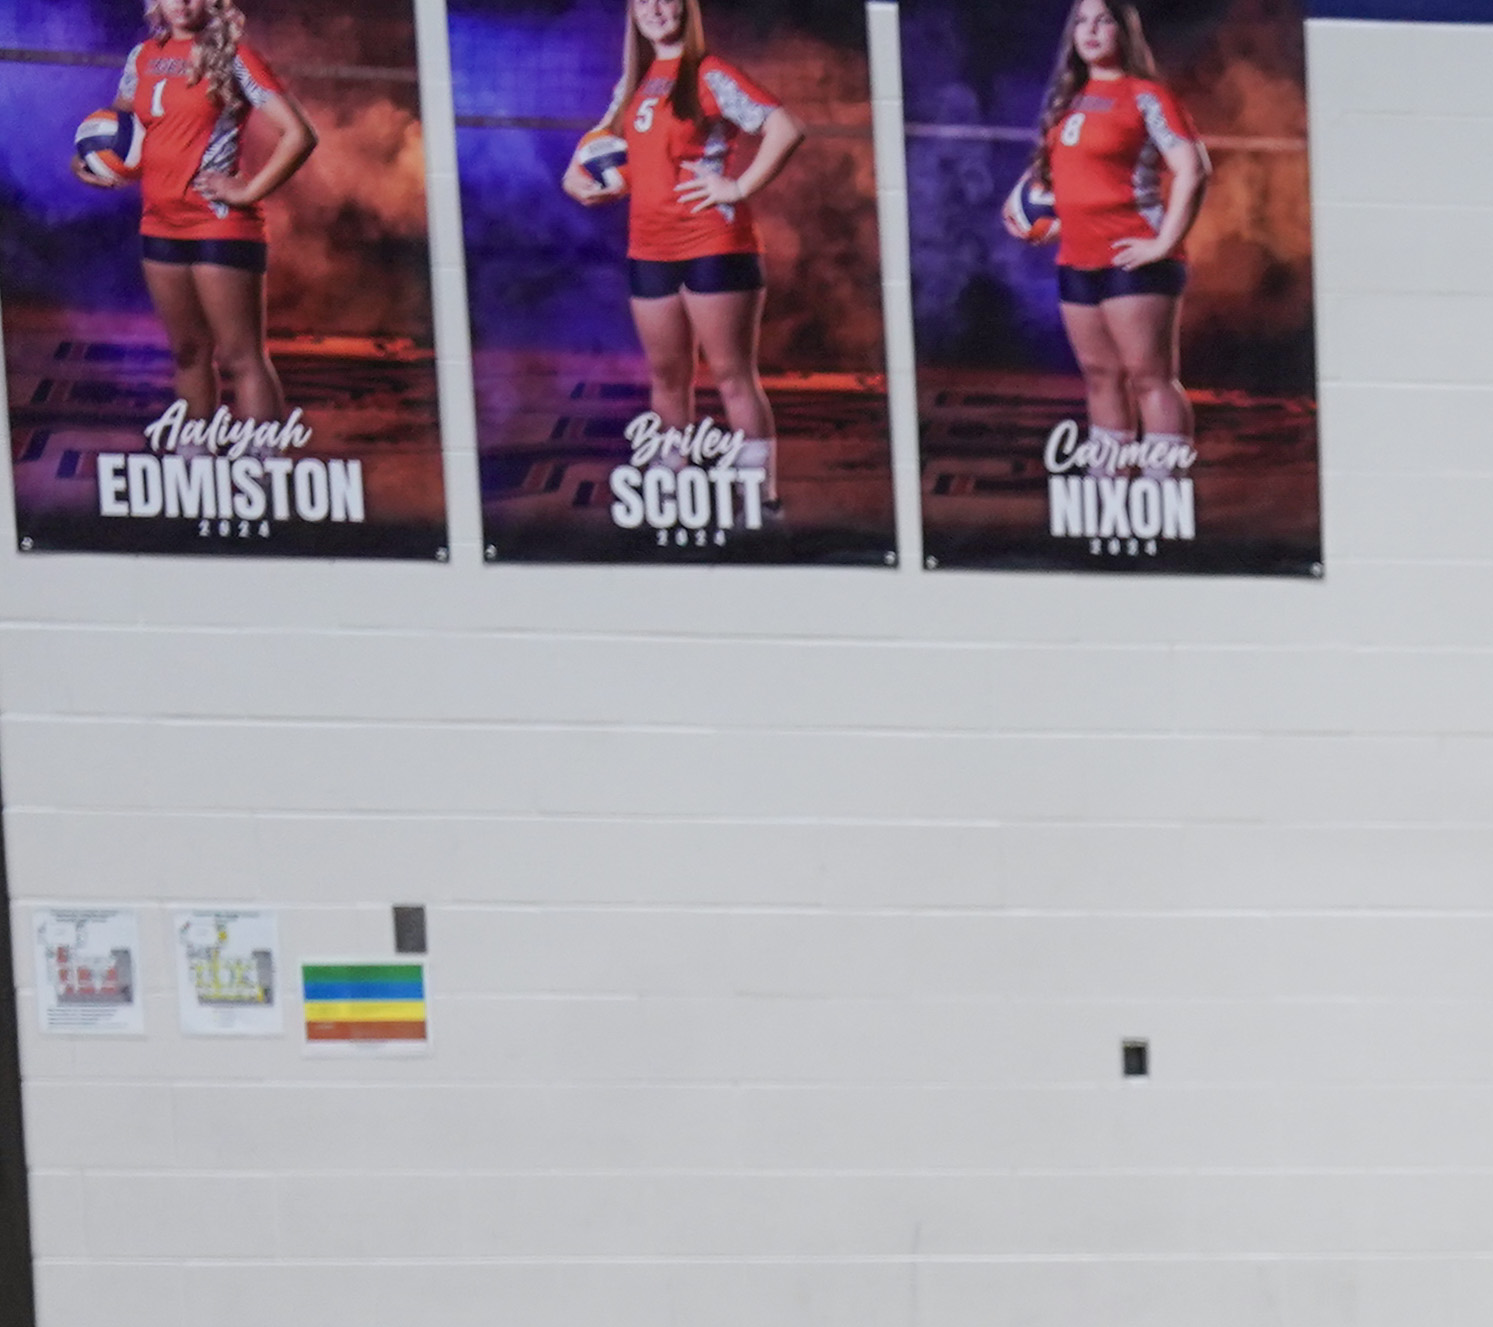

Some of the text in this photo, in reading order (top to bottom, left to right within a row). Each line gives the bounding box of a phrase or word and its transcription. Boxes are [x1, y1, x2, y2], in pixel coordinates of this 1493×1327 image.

[150, 77, 167, 117] 1
[633, 97, 659, 133] 5
[1061, 112, 1086, 147] 8
[144, 399, 312, 461] Aaliyah
[624, 411, 746, 470] Briley
[1043, 418, 1199, 476] Carmen
[97, 452, 365, 523] EDMISTON
[609, 463, 767, 530] SCOTT
[1049, 475, 1197, 540] NIXON
[198, 518, 271, 539] 2024
